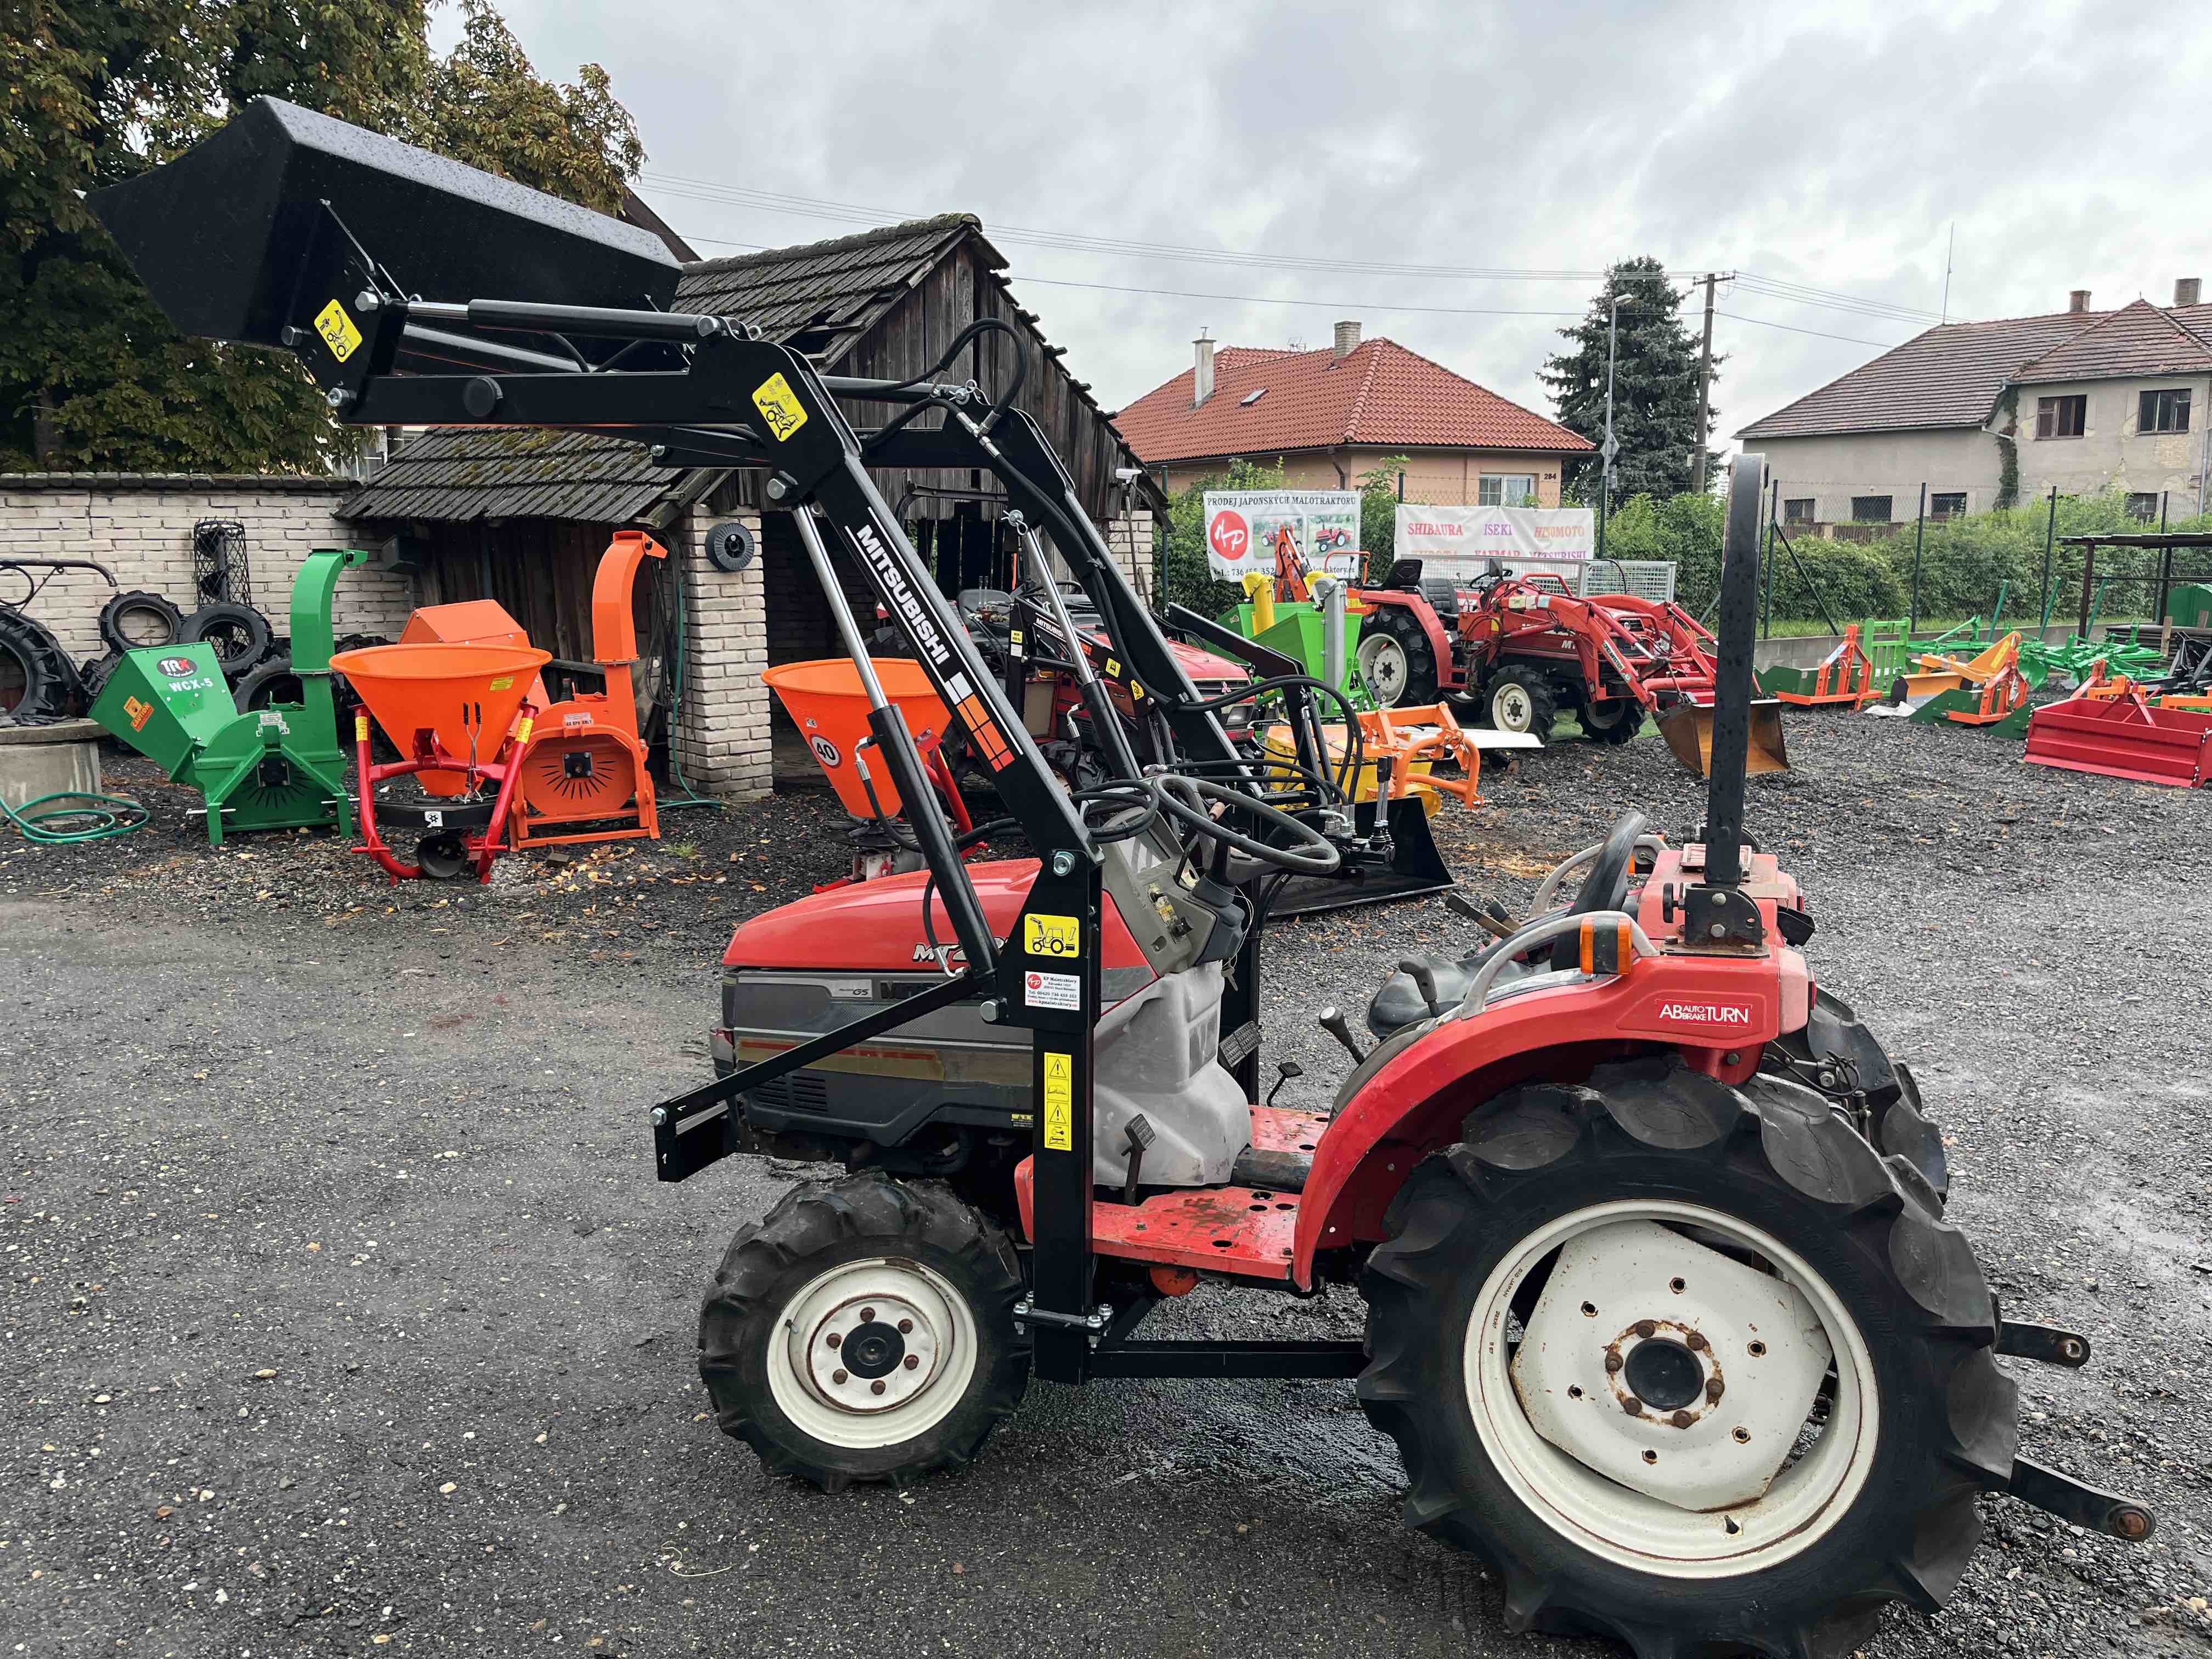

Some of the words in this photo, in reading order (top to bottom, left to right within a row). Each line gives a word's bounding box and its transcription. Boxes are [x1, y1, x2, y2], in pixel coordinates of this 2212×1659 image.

[1207, 497, 1237, 506] PRODEJ
[1408, 523, 1464, 536] SHIBAURA
[1483, 523, 1513, 535] ISEKI
[1536, 526, 1585, 538] HINOMOTO
[856, 524, 950, 665] MITSUBISHI
[1036, 617, 1066, 639] MITSUBIS
[160, 659, 190, 672] TRX
[168, 678, 213, 692] WCX-5
[816, 742, 836, 761] 40
[1659, 1004, 1682, 1019] AB
[1682, 1013, 1707, 1021] BRAKE
[1705, 1006, 1749, 1023] TURN
[1503, 1278, 1515, 1298] JAPAN
